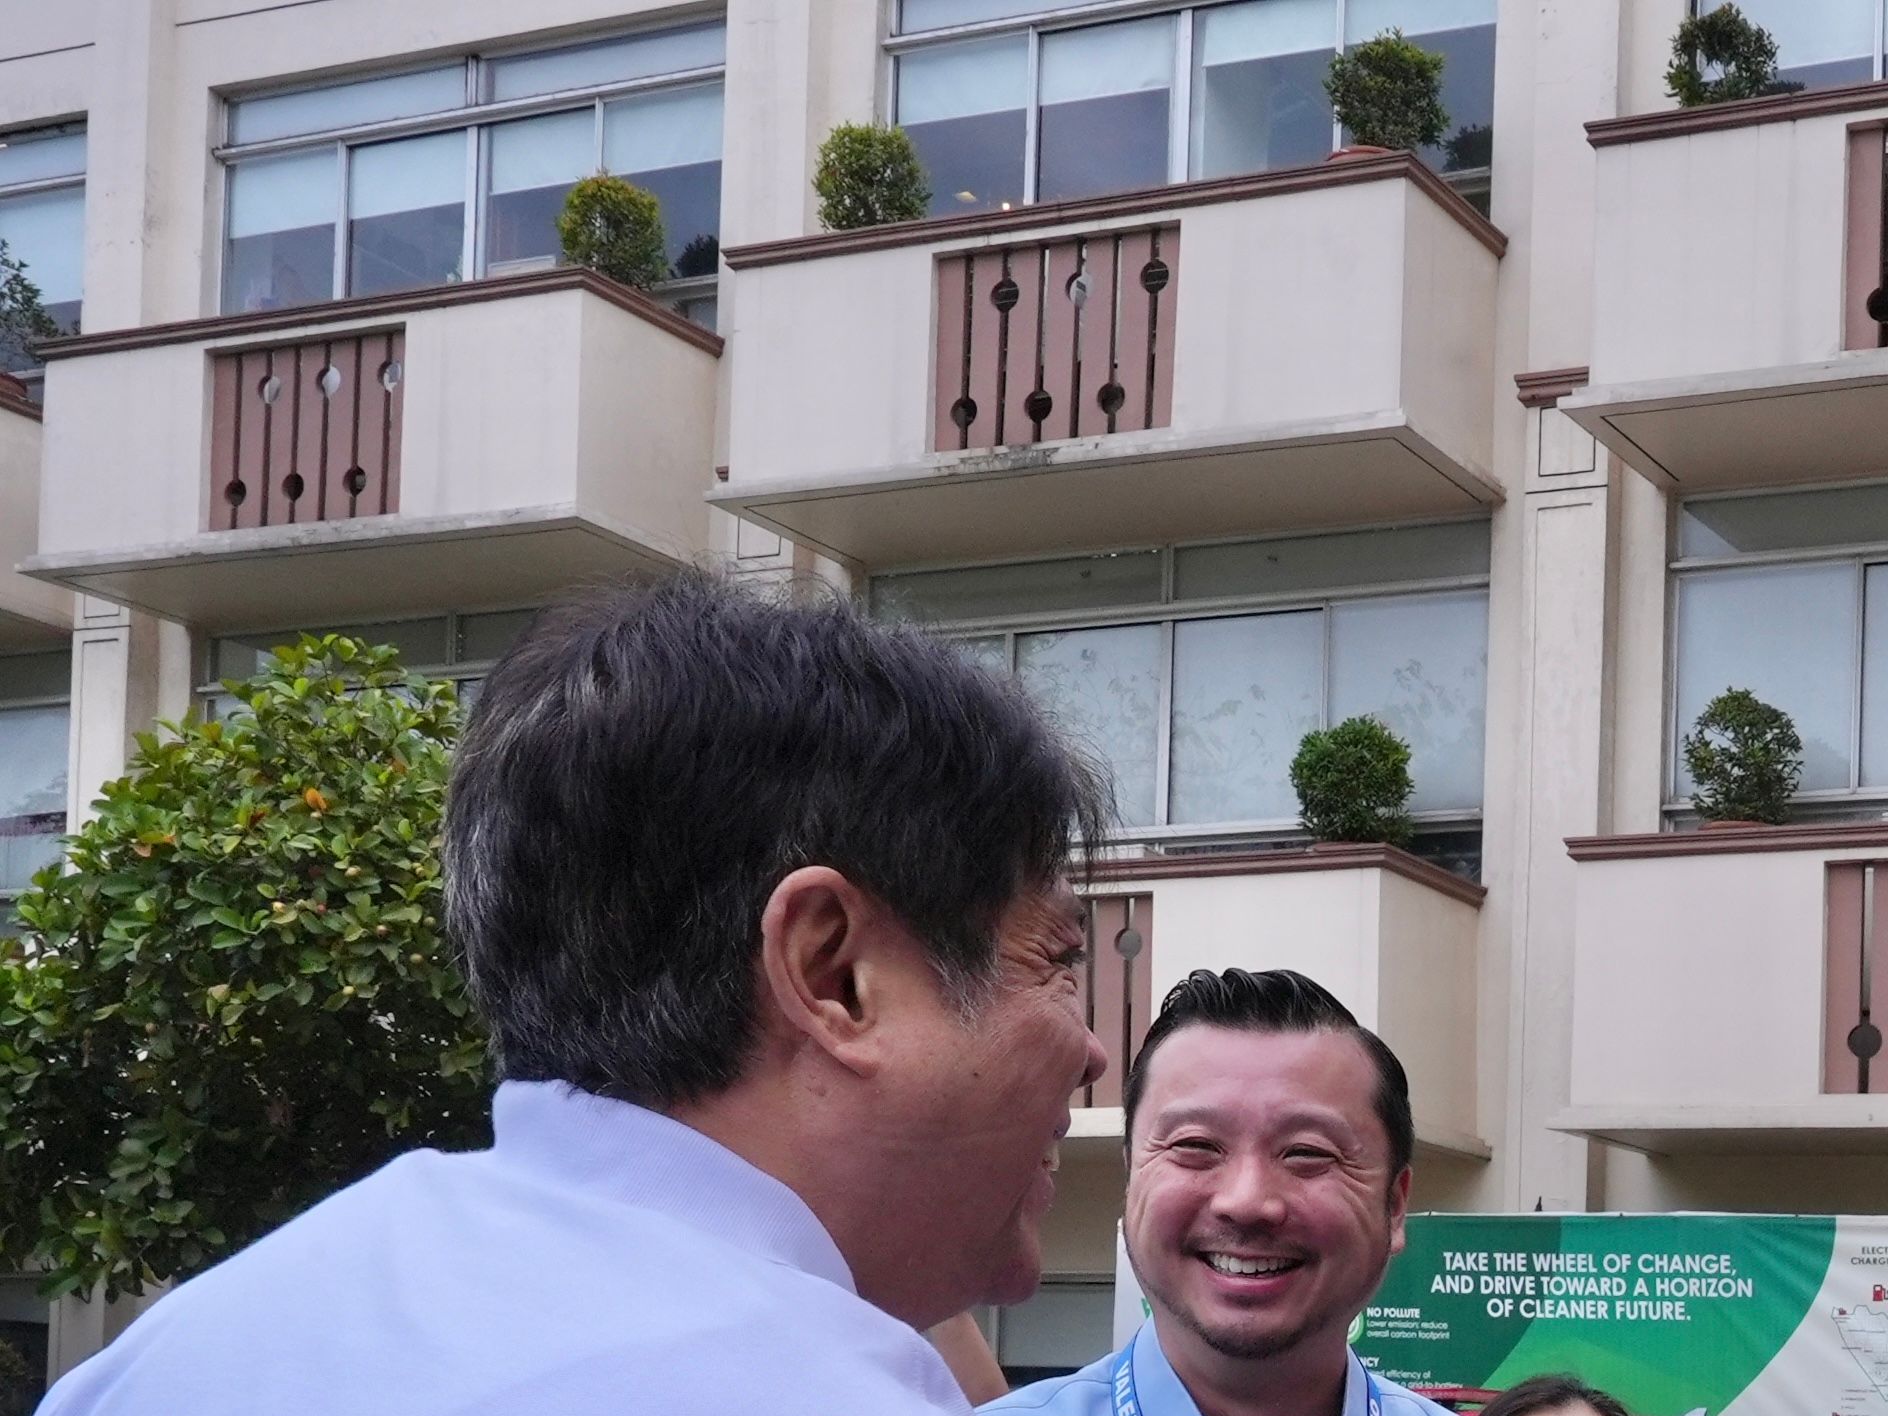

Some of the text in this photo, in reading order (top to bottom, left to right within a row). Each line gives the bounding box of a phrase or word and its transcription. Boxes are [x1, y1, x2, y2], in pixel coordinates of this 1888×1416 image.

[1443, 1252, 1737, 1277] TAKE THE WHEEL OF CHANGE,
[1430, 1274, 1754, 1298] AND DRIVE TOWARD A HORIZON
[1366, 1307, 1420, 1318] NO POLLUTE
[1486, 1298, 1692, 1321] OF CLEANER FUTURE.
[1390, 1330, 1417, 1339] carbon
[1418, 1330, 1450, 1341] footprint
